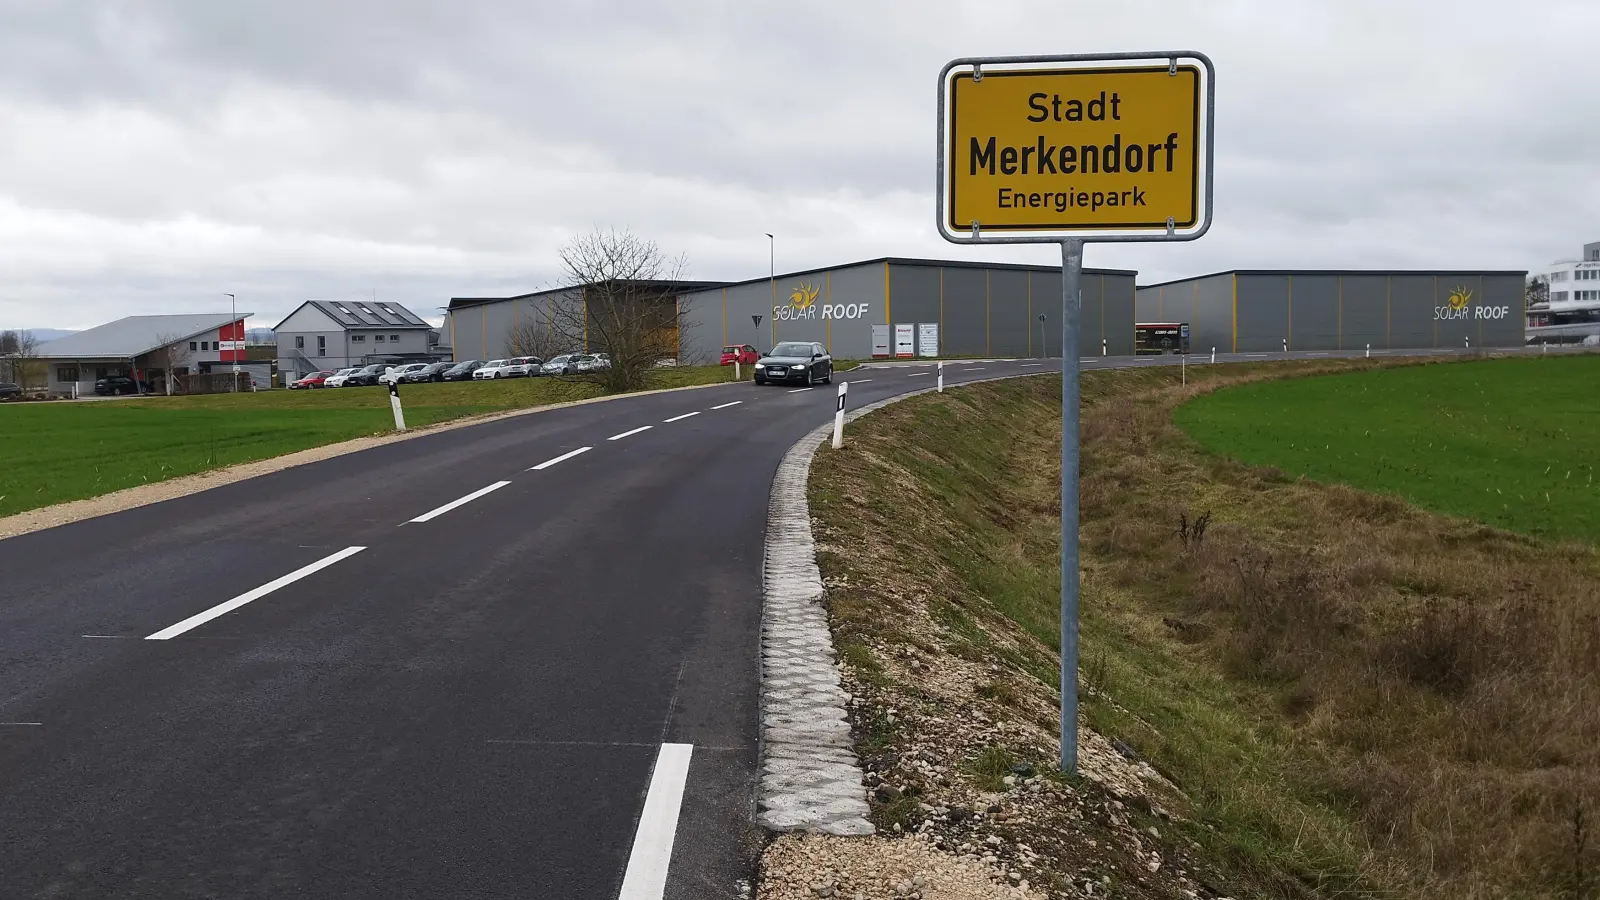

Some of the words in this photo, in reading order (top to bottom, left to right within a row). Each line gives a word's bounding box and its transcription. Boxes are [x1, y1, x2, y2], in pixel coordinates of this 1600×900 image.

[1027, 91, 1121, 122] Stadt
[969, 132, 1178, 175] Merkendorf
[998, 186, 1147, 212] Energiepark
[773, 304, 816, 320] SOLAR
[822, 303, 869, 320] ROOF
[1433, 306, 1469, 320] SOLAR
[1474, 305, 1509, 319] ROOF
